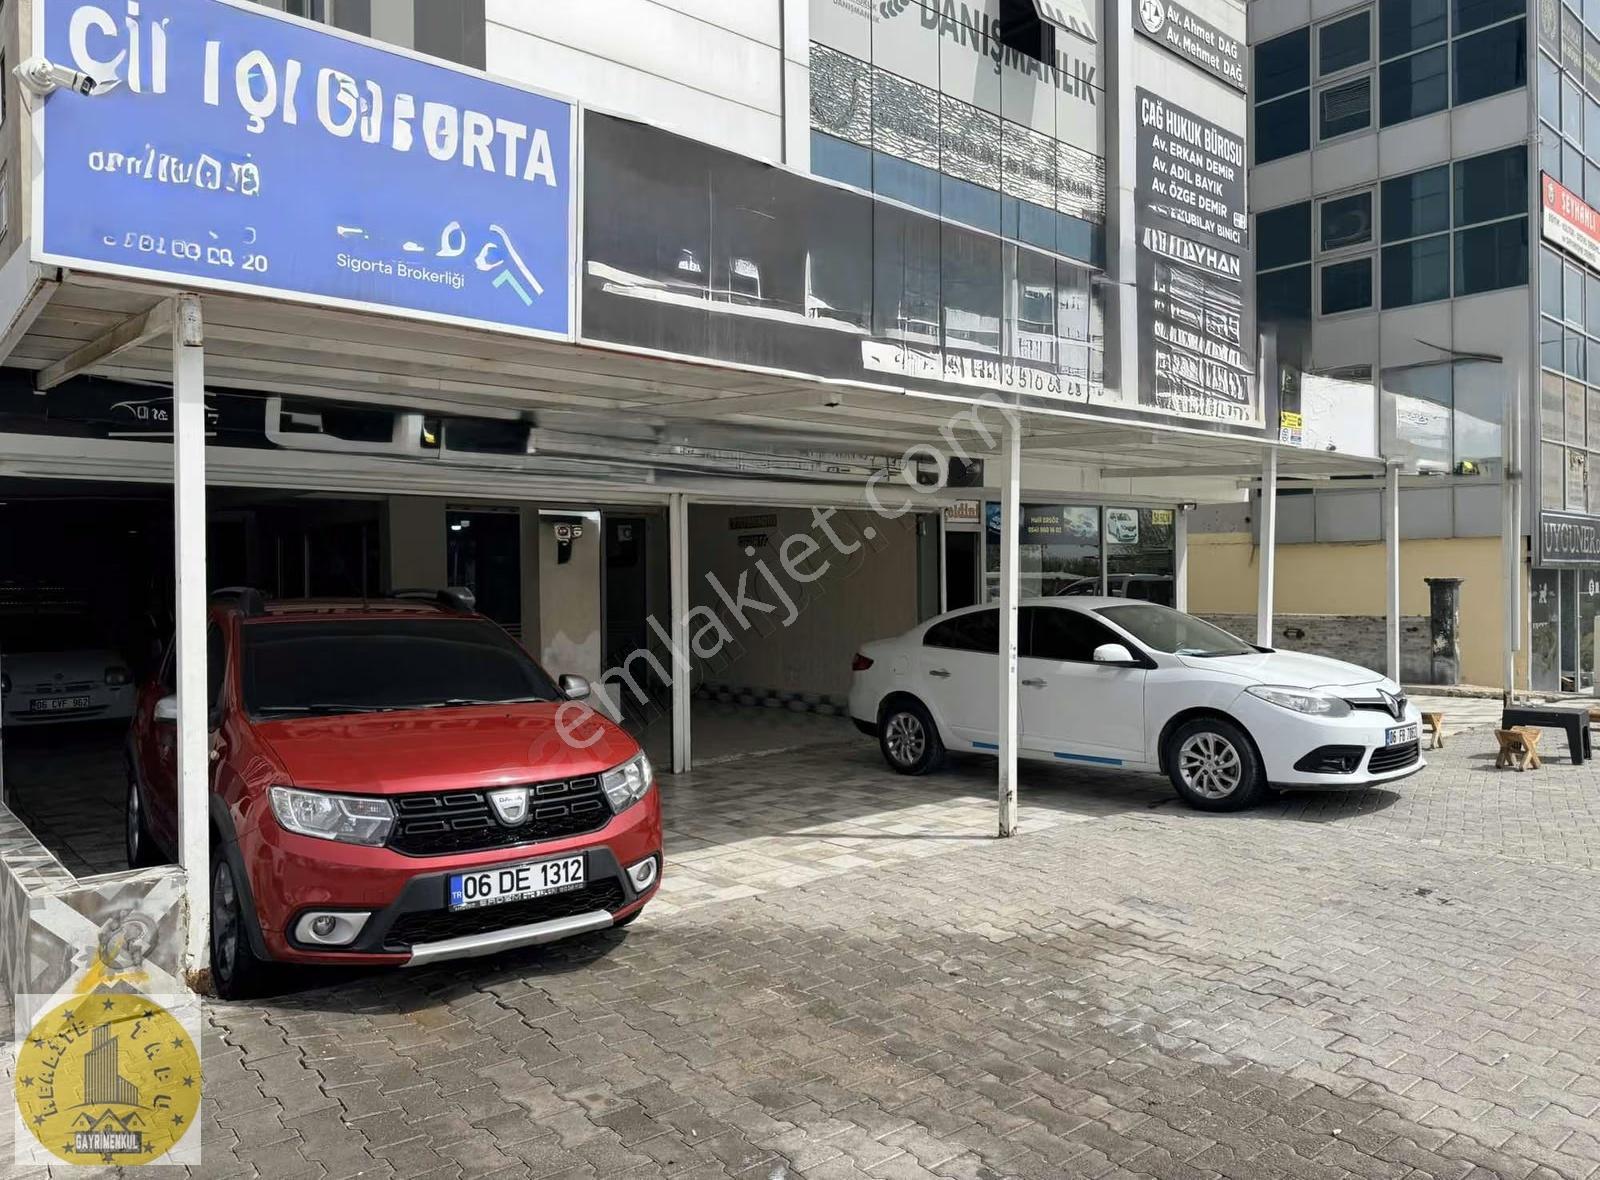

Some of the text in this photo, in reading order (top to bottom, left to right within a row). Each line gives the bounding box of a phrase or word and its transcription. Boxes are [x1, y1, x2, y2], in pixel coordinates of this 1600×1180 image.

[1167, 5, 1182, 26] Av.
[1183, 15, 1215, 46] Ahmet
[1218, 36, 1238, 59] DAĞ
[1166, 26, 1242, 82] Av. Mehmet DAĞ
[1141, 98, 1242, 167] ÇAĞ HUKUK BÜROSU
[1152, 134, 1168, 152] Av.
[1170, 141, 1203, 168] ERKAN
[1152, 155, 1168, 174] Av.
[1195, 173, 1223, 196] BAYIK
[1152, 177, 1167, 195] Av.
[1169, 181, 1196, 206] ÖZGE
[336, 253, 465, 289] Sigorta Brokerliği
[464, 873, 492, 900] 06
[499, 868, 531, 894] DE
[541, 859, 583, 887] 1312
